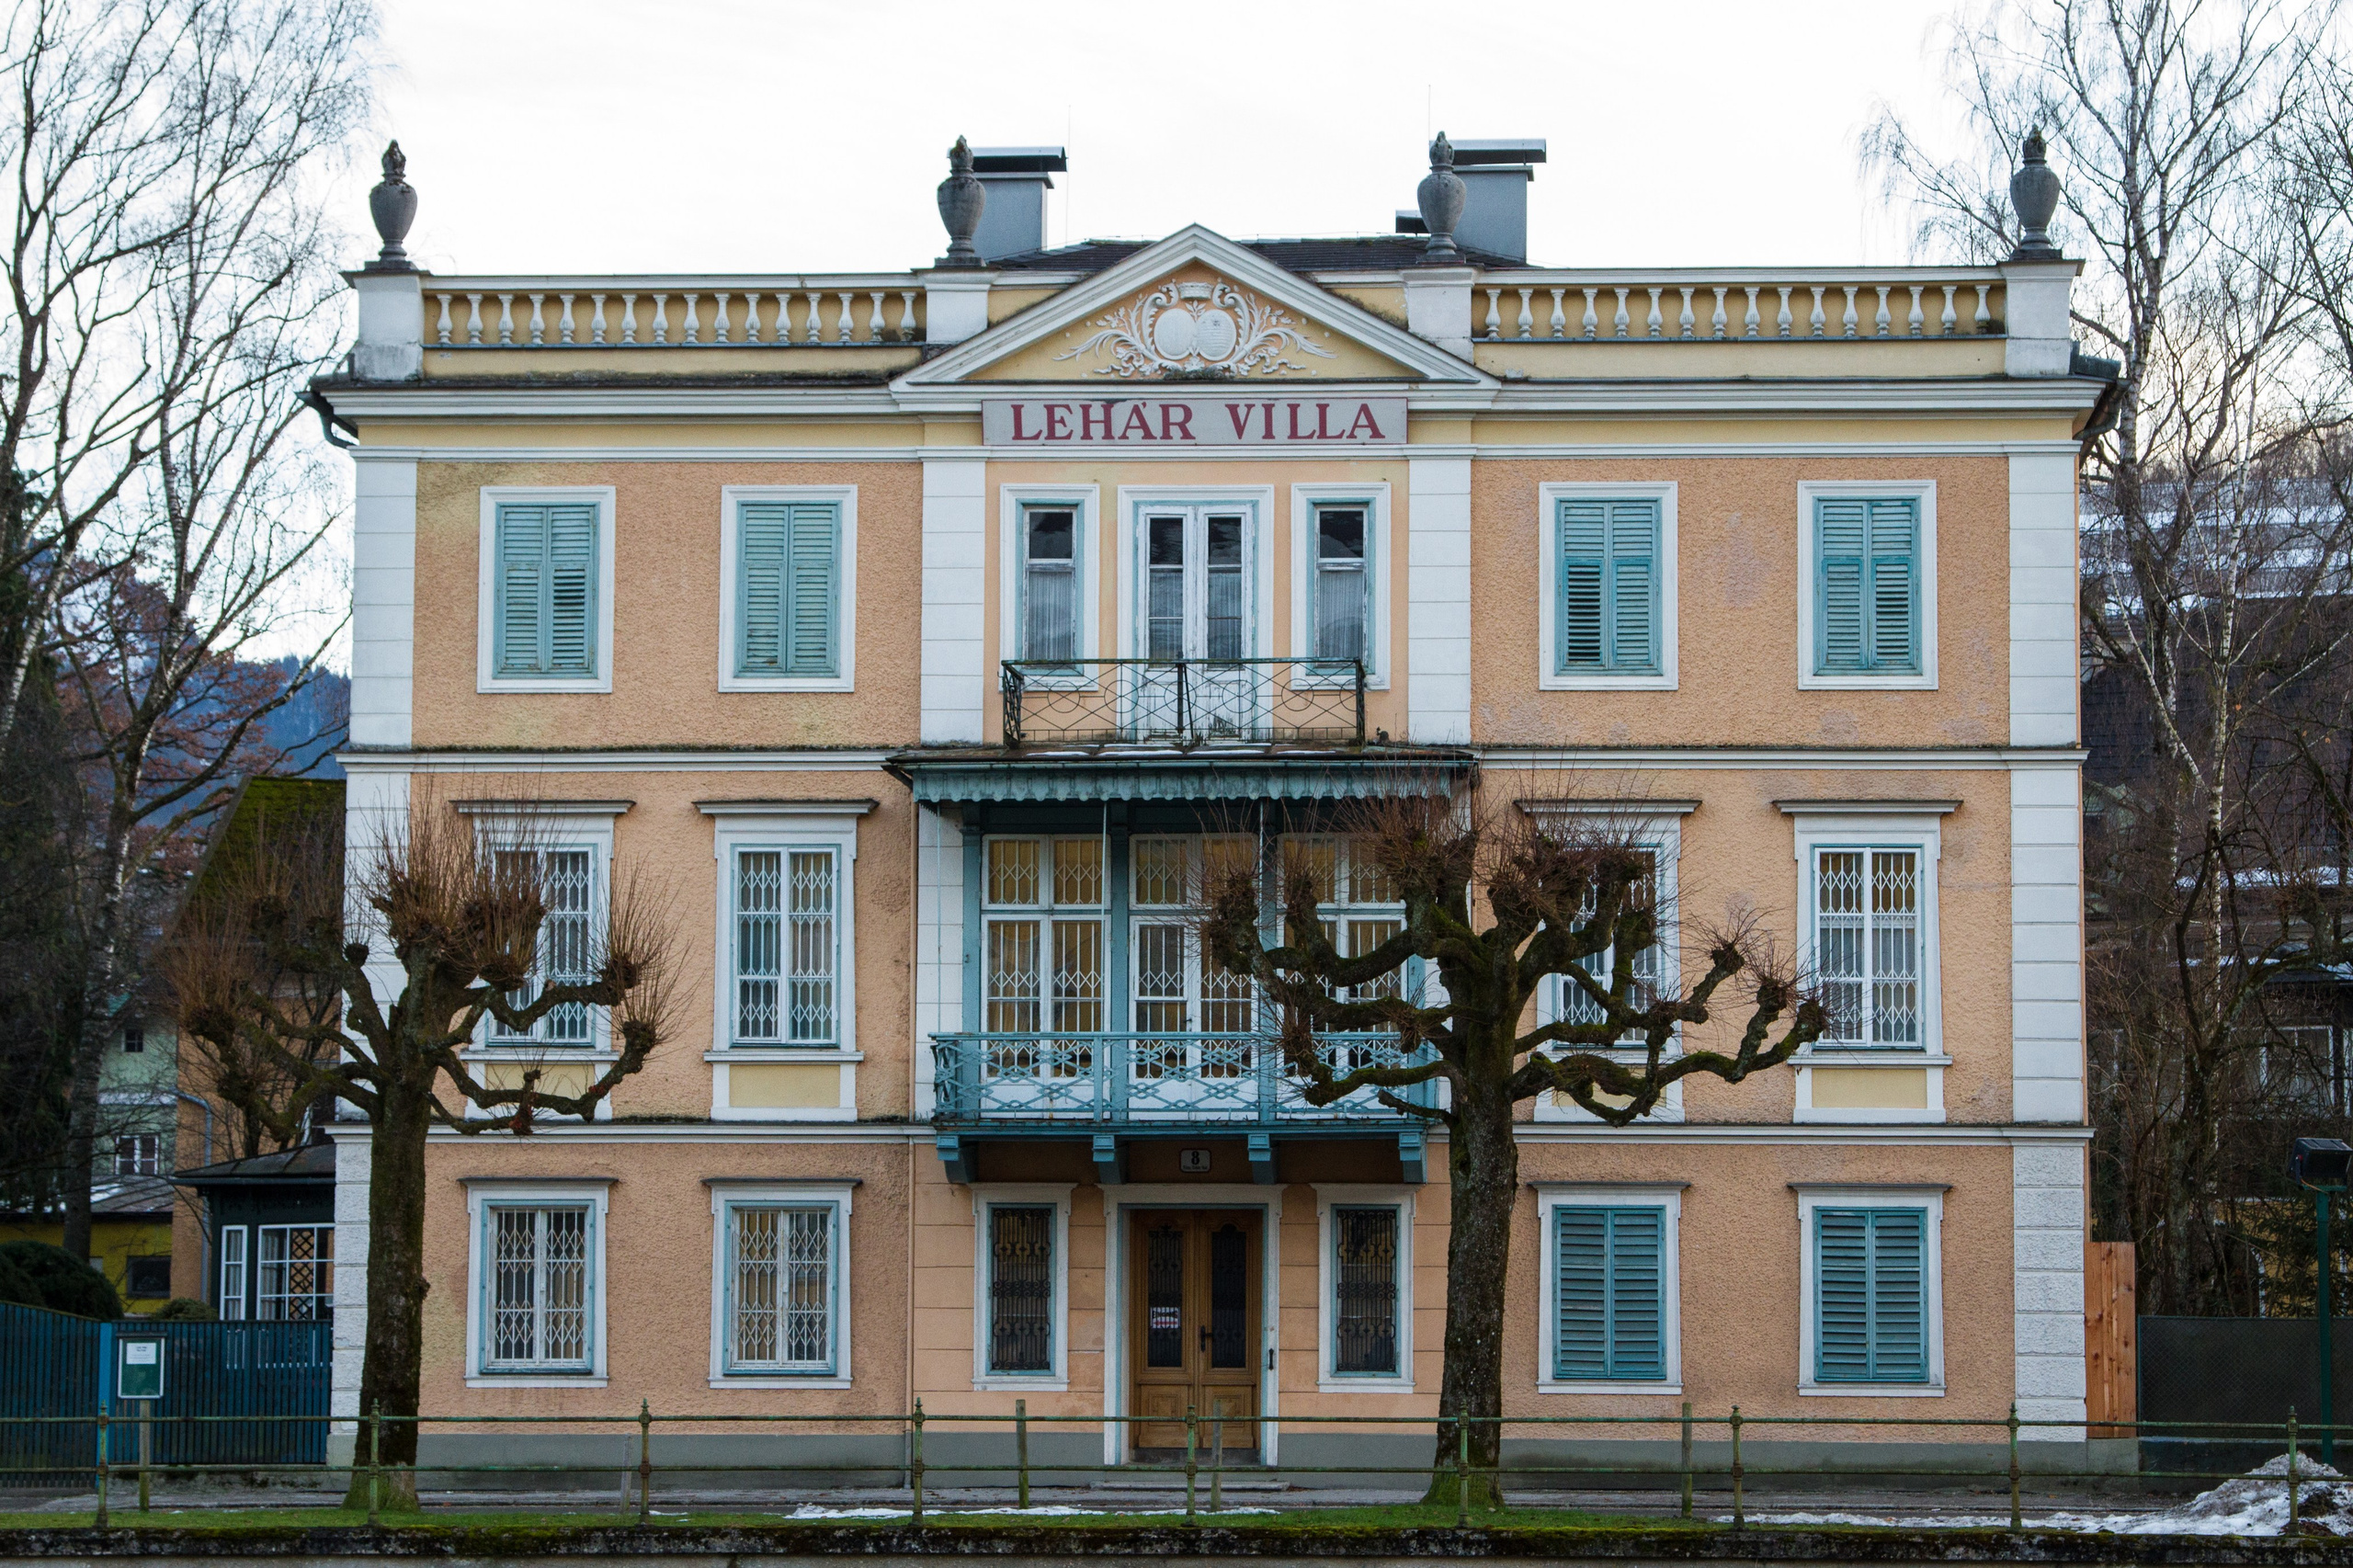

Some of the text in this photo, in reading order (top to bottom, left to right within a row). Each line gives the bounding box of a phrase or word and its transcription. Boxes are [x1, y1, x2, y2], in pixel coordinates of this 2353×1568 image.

[1011, 402, 1385, 440] LEHÁR VILLA
[1191, 1151, 1199, 1165] 8
